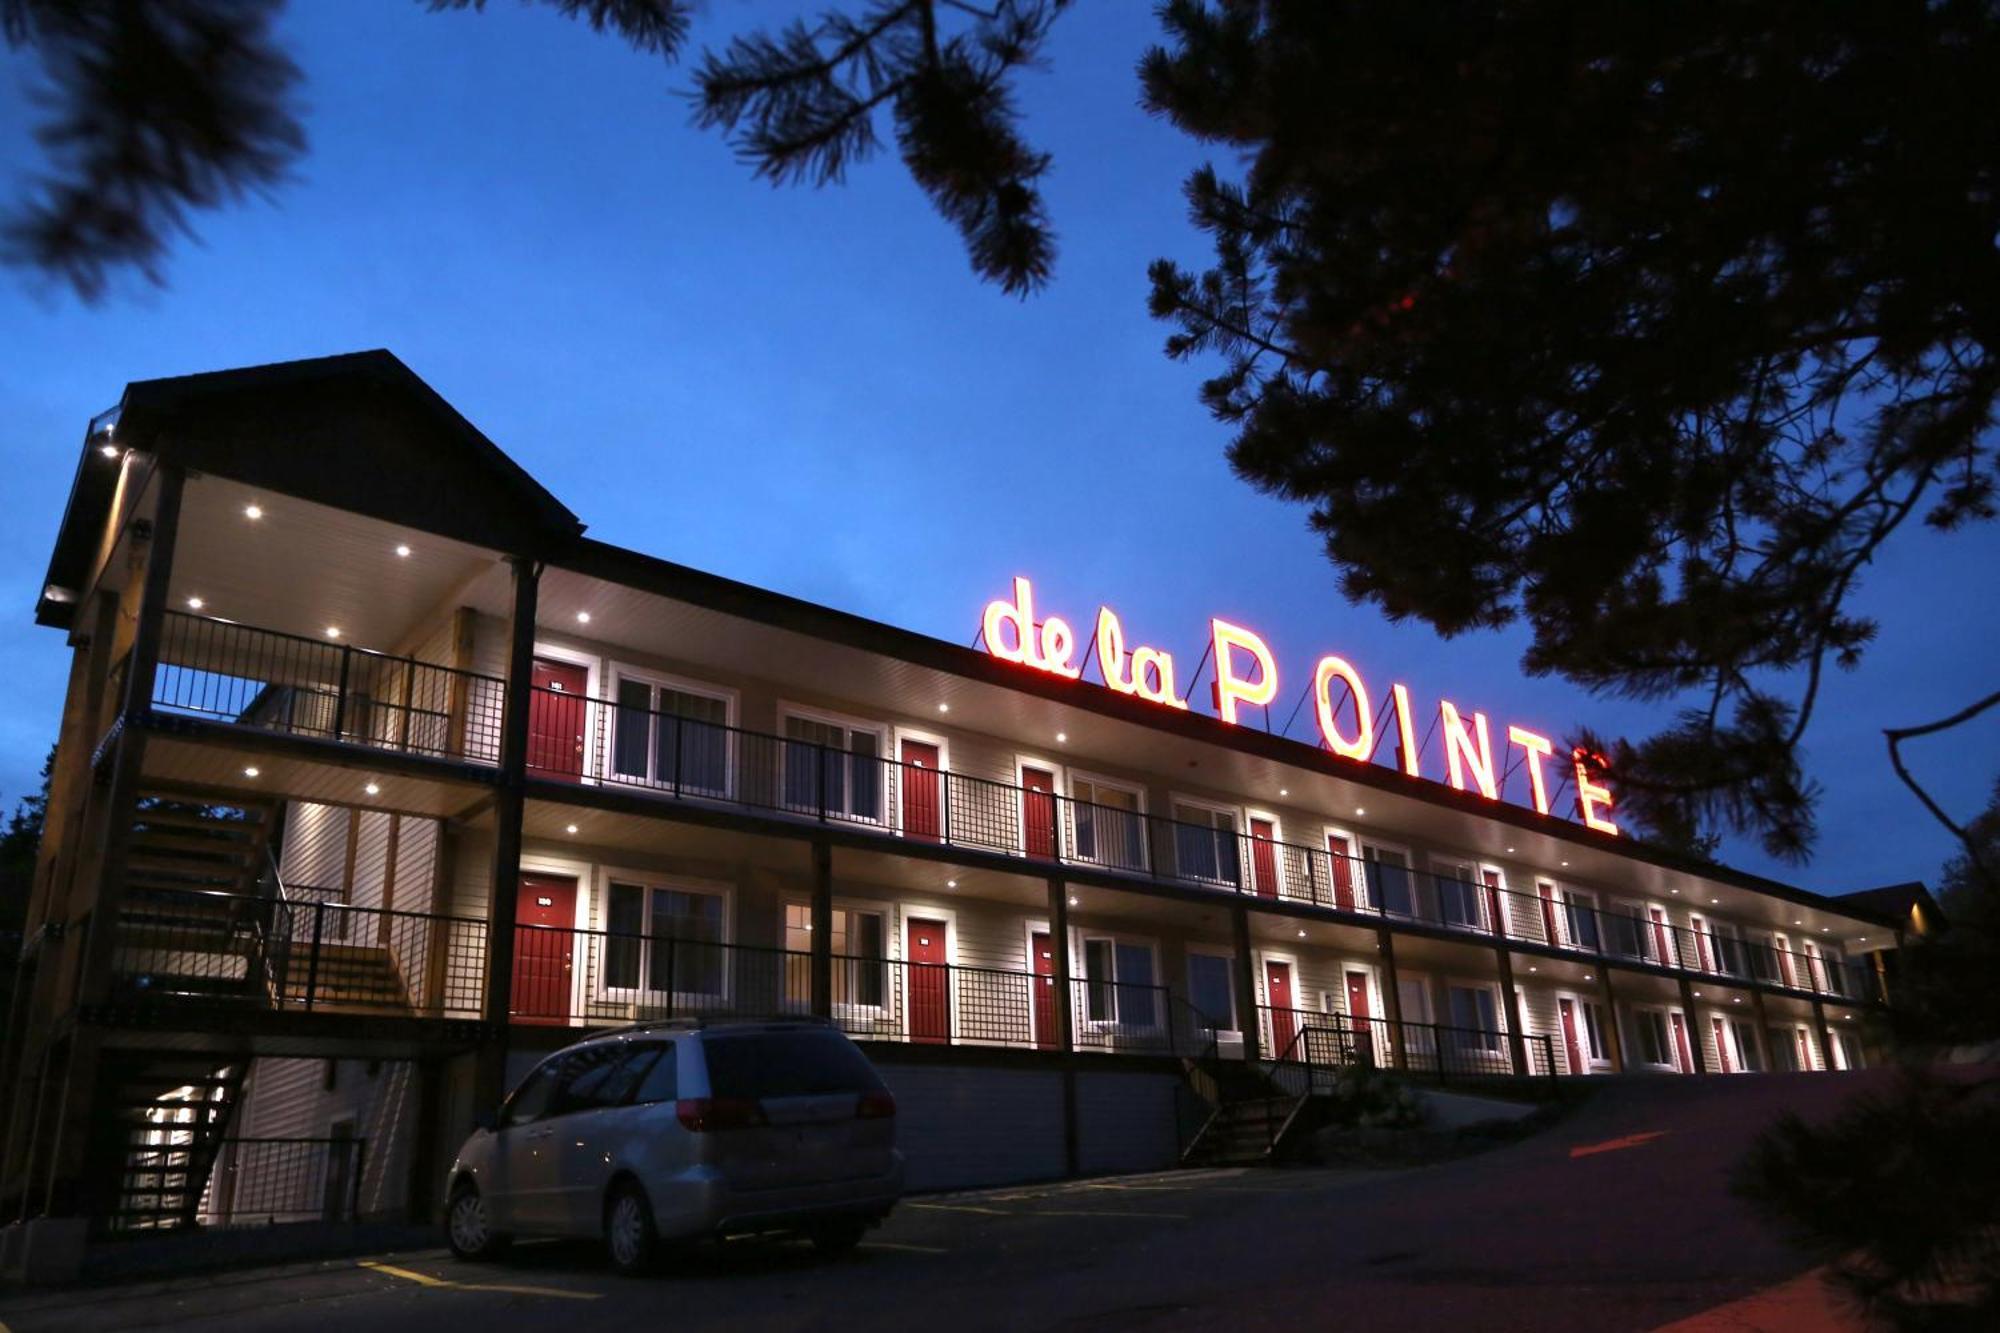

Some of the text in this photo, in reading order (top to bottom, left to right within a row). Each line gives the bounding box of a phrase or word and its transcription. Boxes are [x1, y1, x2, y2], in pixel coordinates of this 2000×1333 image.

[982, 576, 1619, 836] de la POINTE
